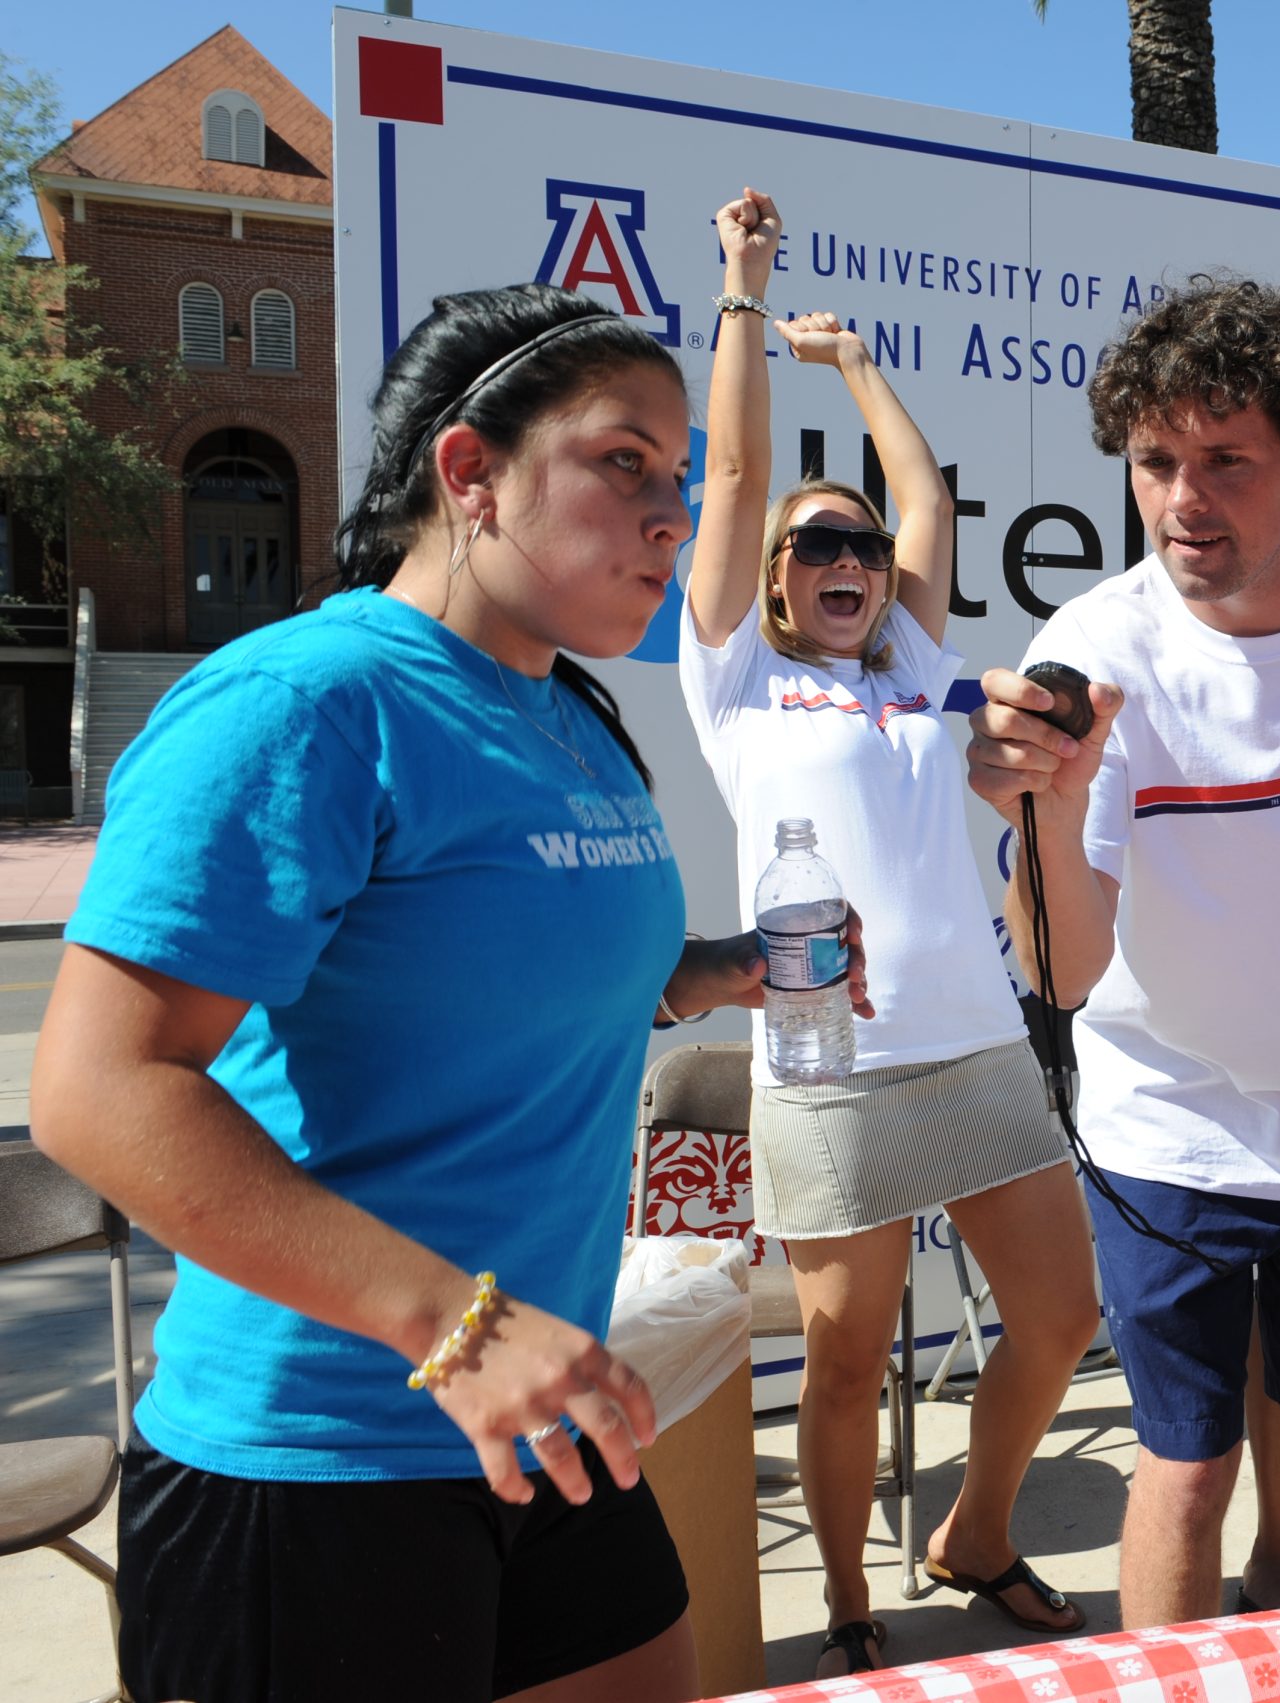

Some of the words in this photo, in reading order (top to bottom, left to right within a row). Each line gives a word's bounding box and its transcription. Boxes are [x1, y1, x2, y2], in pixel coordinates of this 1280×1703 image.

[812, 231, 1042, 303] UNIVERSITY
[1060, 271, 1101, 310] OF
[961, 323, 1110, 389] ASSO
